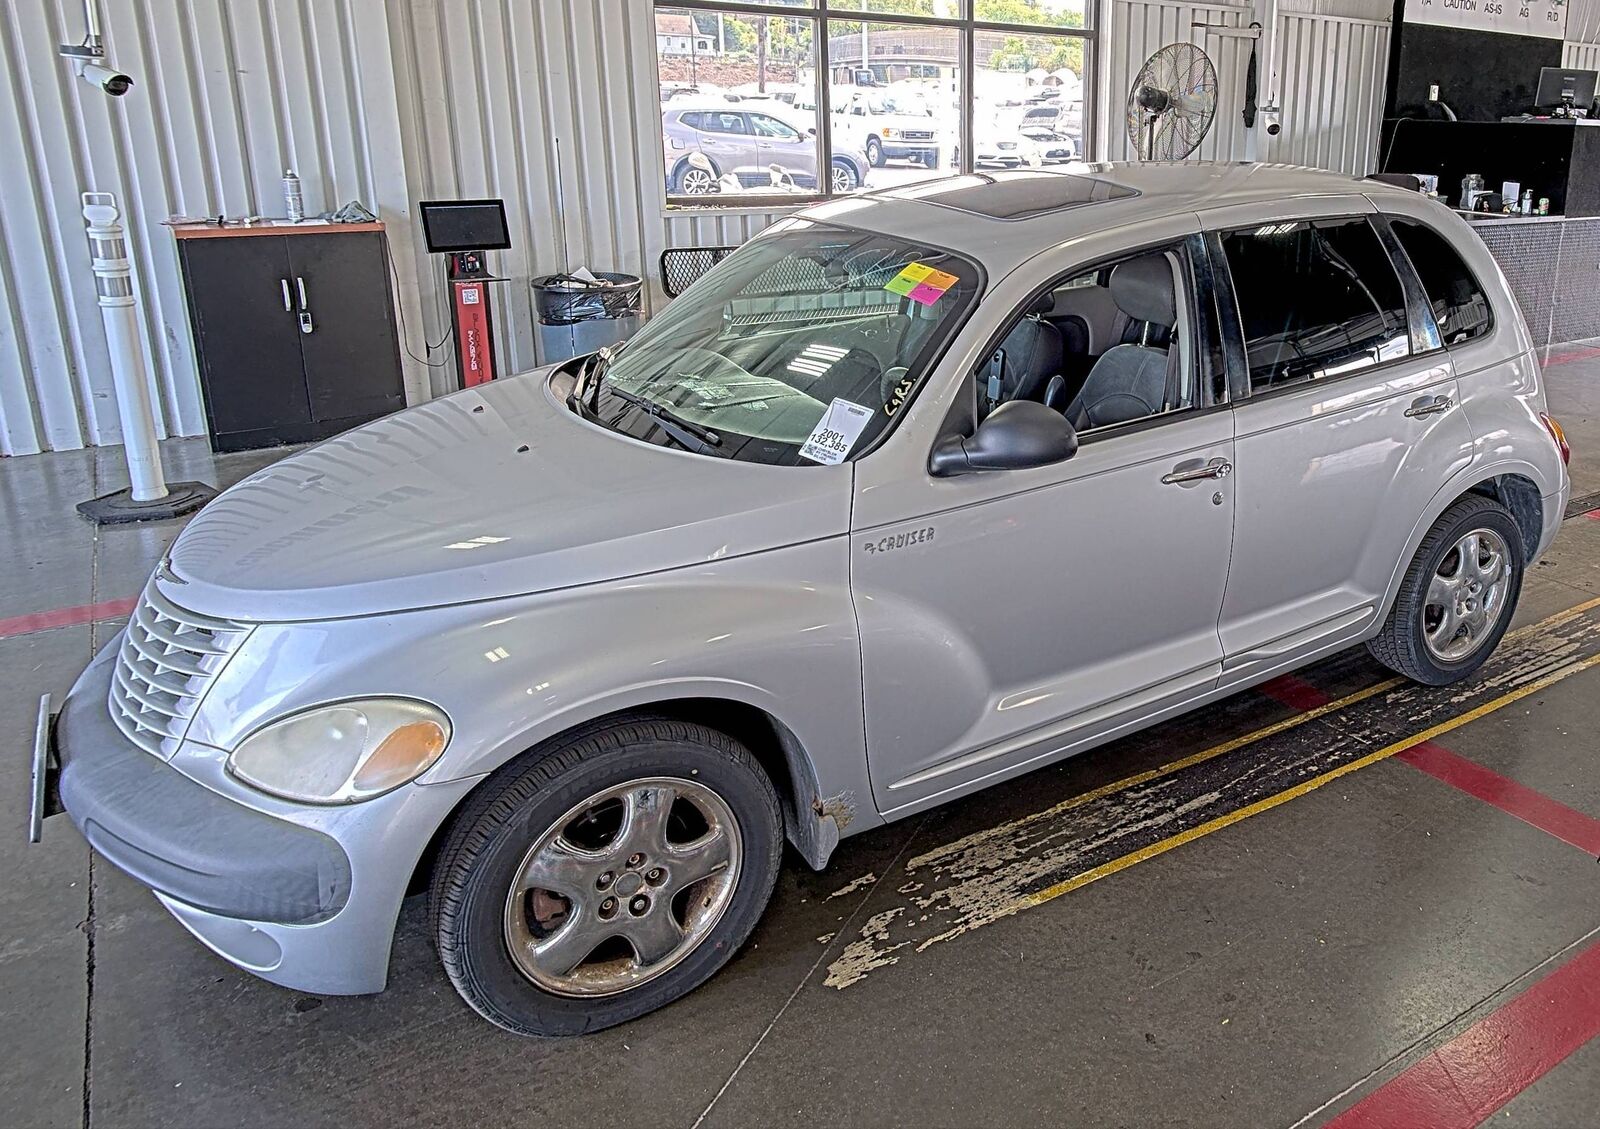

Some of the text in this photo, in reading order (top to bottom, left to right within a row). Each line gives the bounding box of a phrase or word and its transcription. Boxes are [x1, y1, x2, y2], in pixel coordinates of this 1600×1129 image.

[1443, 0, 1476, 10] CAUTION
[1483, 3, 1502, 14] AS-IS
[1519, 7, 1529, 17] AG
[467, 330, 477, 370] IMAGING
[810, 433, 848, 453] 132,385
[820, 427, 845, 443] 2001
[878, 527, 935, 552] CRUISER
